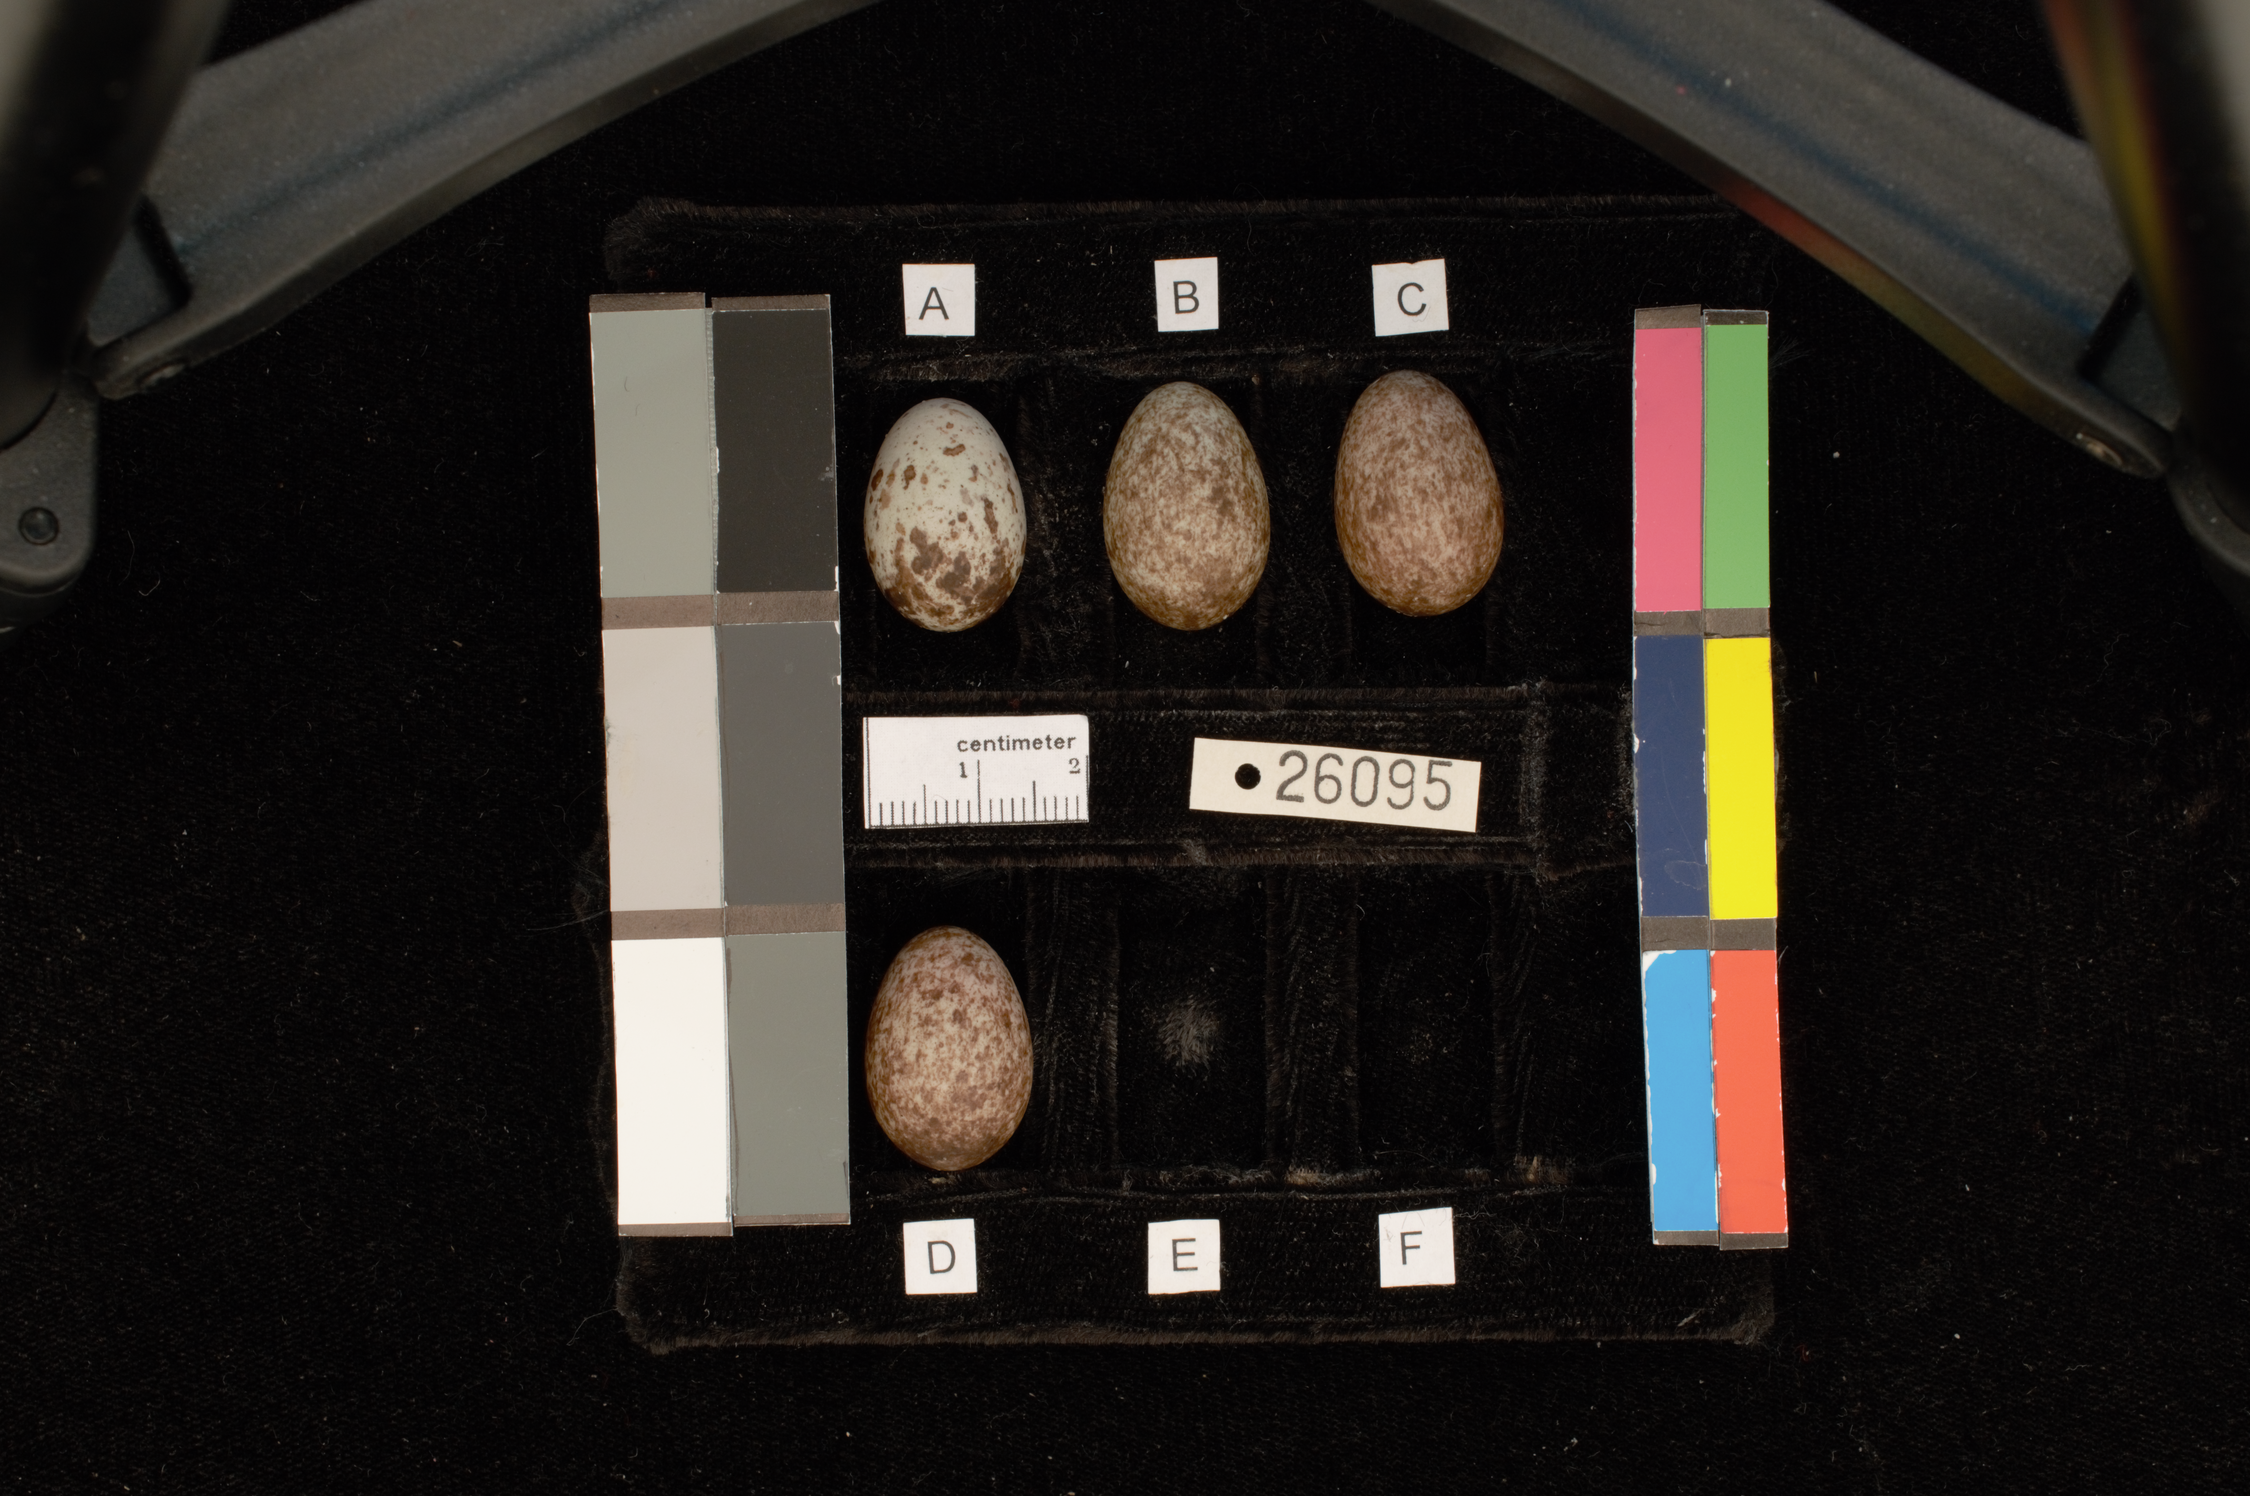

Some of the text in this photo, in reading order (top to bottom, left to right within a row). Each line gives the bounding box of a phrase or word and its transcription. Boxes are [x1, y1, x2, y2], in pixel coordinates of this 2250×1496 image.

[919, 287, 949, 320] A
[1173, 280, 1200, 314] B
[1397, 282, 1427, 316] C
[957, 734, 1076, 753] centimeter
[958, 757, 1081, 779] 1 2
[1276, 750, 1453, 811] 26095
[927, 1240, 956, 1275] D
[1172, 1238, 1198, 1271] E
[1400, 1230, 1423, 1265] F
